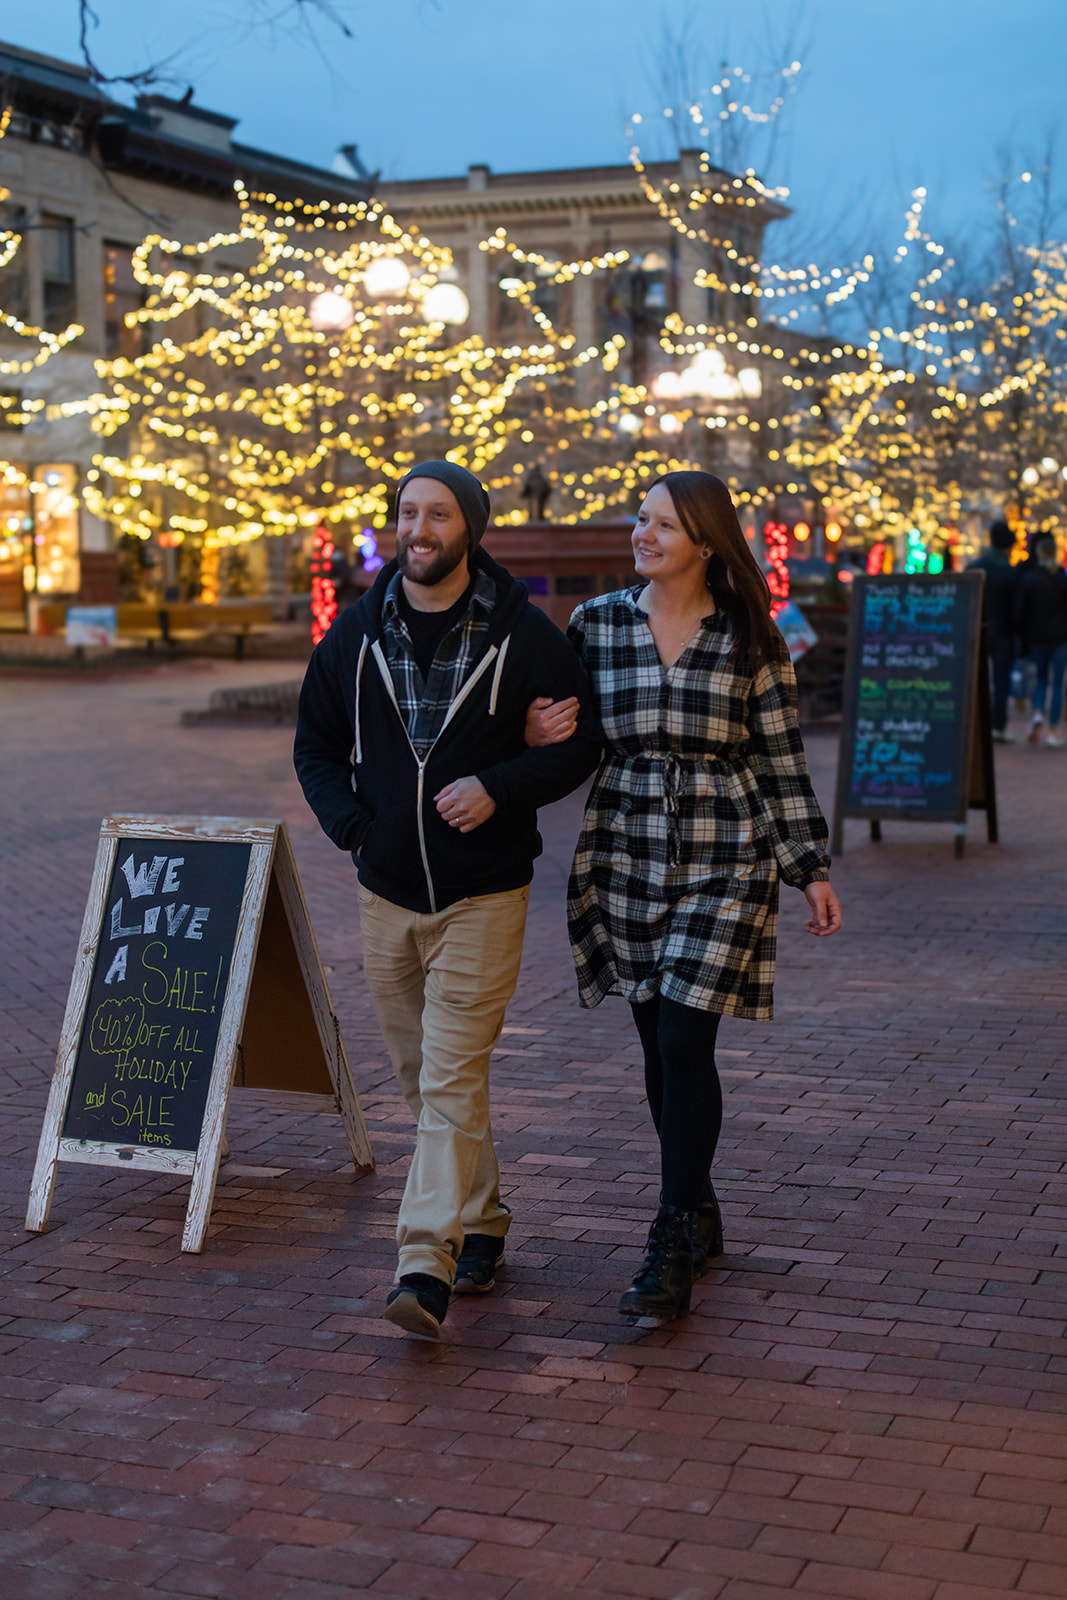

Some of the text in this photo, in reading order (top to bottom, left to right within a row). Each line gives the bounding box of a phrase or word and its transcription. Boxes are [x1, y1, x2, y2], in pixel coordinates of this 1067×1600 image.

[120, 853, 185, 899] WE
[104, 944, 128, 984] A
[99, 1012, 204, 1052] 40% OFF ALL
[114, 1050, 193, 1091] HOLIDAY
[86, 1082, 175, 1126] and SALE
[138, 1128, 172, 1145] items
